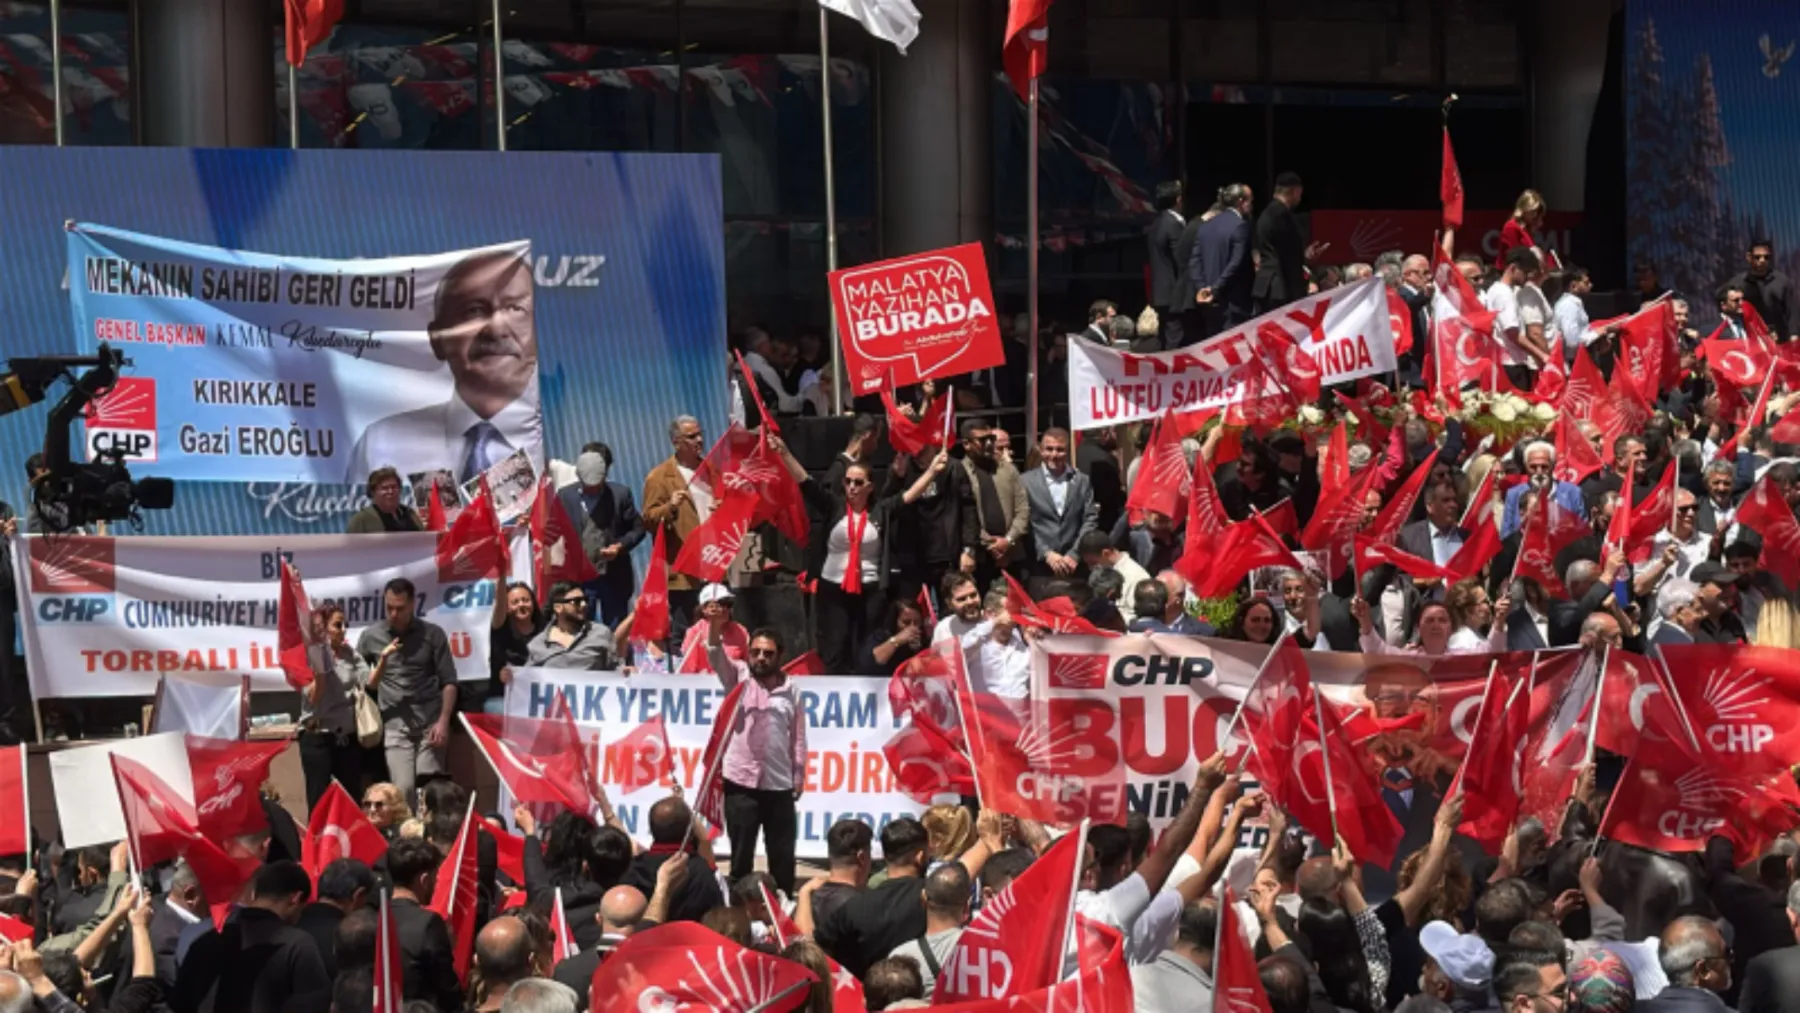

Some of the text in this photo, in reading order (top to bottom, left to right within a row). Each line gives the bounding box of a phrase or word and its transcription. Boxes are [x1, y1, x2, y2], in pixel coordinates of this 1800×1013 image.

[86, 256, 194, 298] MEKANIN
[202, 266, 280, 303] SAHİBİ
[288, 269, 342, 306] GERİ
[350, 268, 415, 310] GELDİ
[534, 255, 605, 287] UZ
[848, 265, 963, 301] MALATYA
[851, 285, 959, 319] YAZIHAN
[856, 297, 990, 341] BURADA
[95, 318, 142, 341] GENEL
[146, 322, 206, 348] BAŞKAN
[1315, 335, 1373, 376] INDA
[193, 379, 317, 408] KIRIKKALE
[1091, 378, 1162, 419] LÜTFÜ
[92, 431, 151, 456] CHP
[179, 422, 334, 457] Gazi EROĞLU
[38, 597, 108, 622] CHP
[124, 594, 256, 628] CUMHURİYET
[81, 647, 238, 672] TORBALI
[1113, 655, 1213, 686] CHP
[529, 682, 725, 724] HAK YEME
[800, 691, 878, 728] RAM
[1048, 695, 1252, 777] BUC
[1706, 724, 1774, 753] CHP
[1016, 771, 1084, 802] CHP
